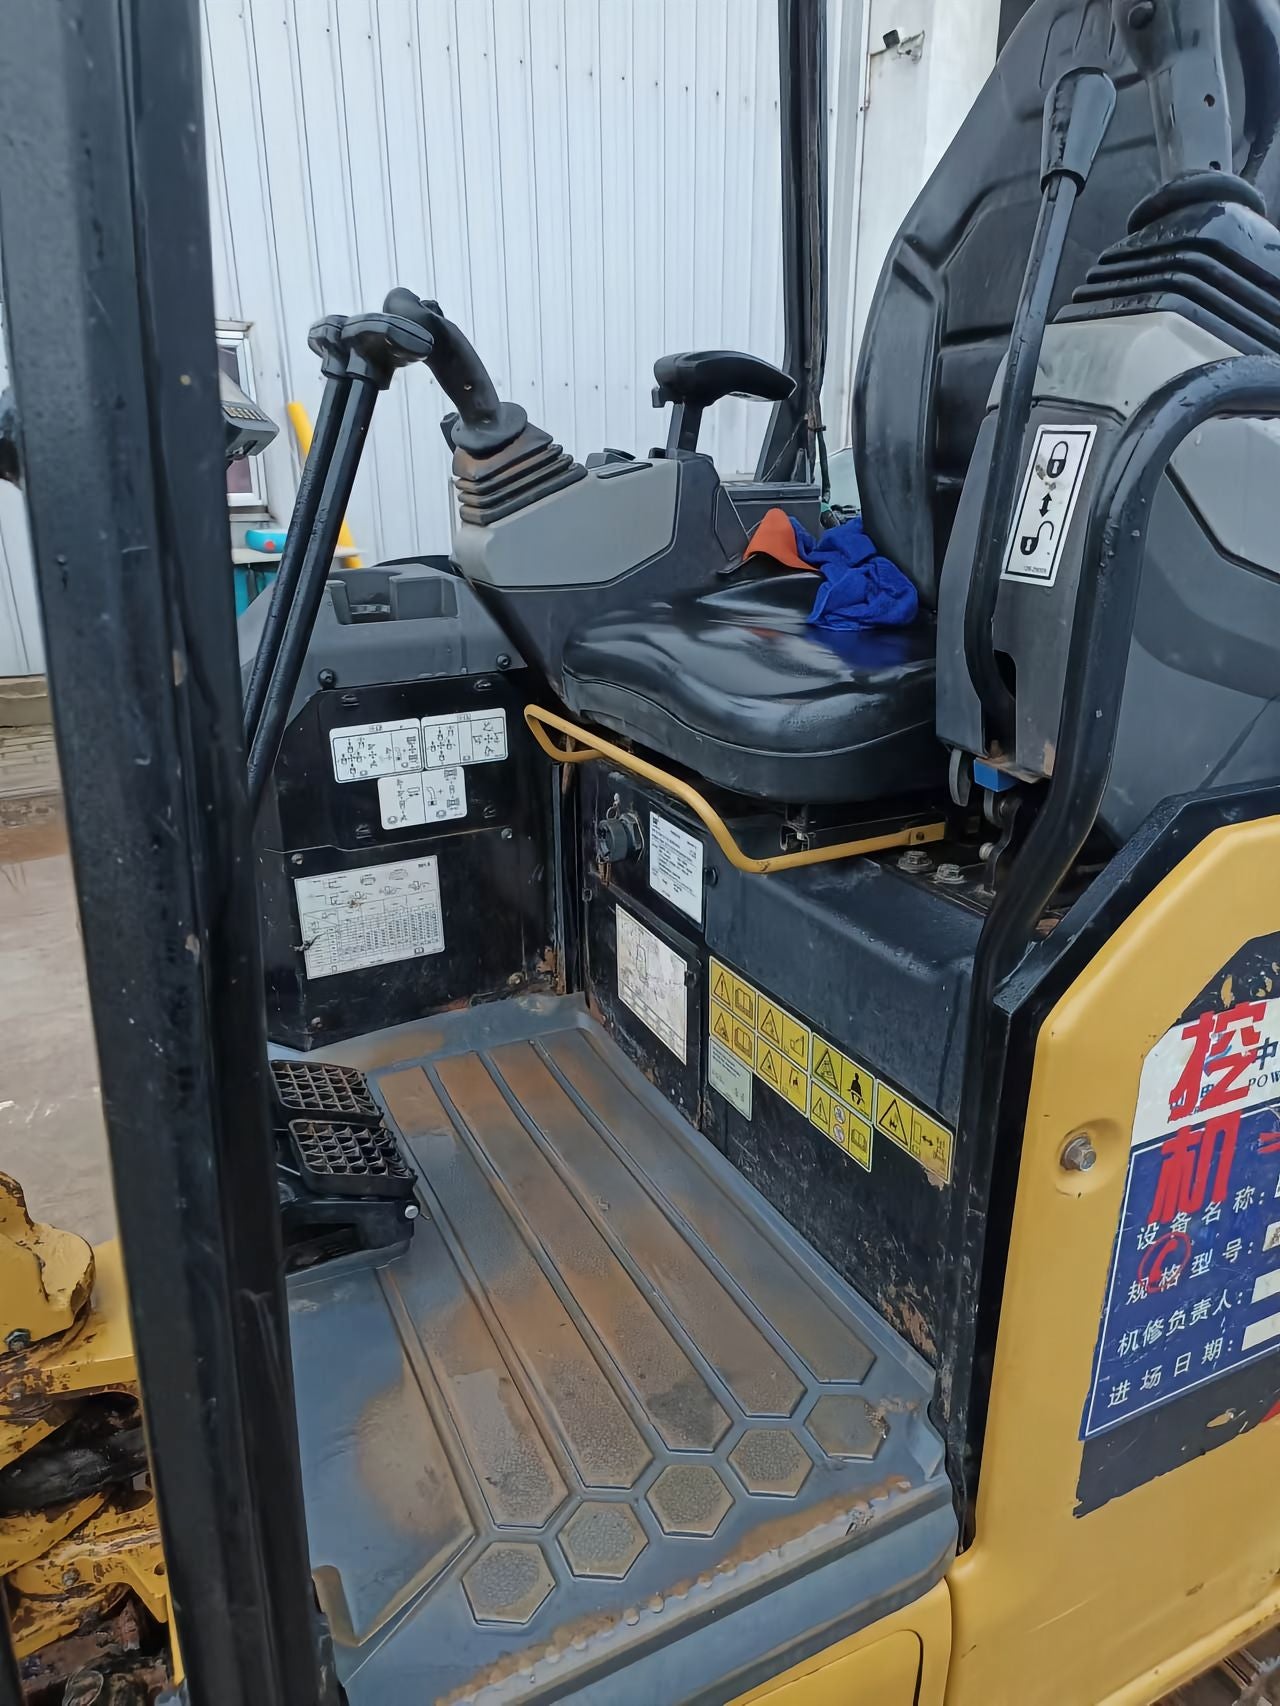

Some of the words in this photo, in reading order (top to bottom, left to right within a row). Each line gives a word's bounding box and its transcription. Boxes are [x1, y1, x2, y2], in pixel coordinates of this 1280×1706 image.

[1147, 1001, 1267, 1224] 挖机
[1137, 1186, 1265, 1250] 设备名称：
[1126, 1238, 1254, 1305] 规格型号：
[1117, 1289, 1243, 1358] 机修负责人：
[1107, 1337, 1234, 1408] 进场日期：
